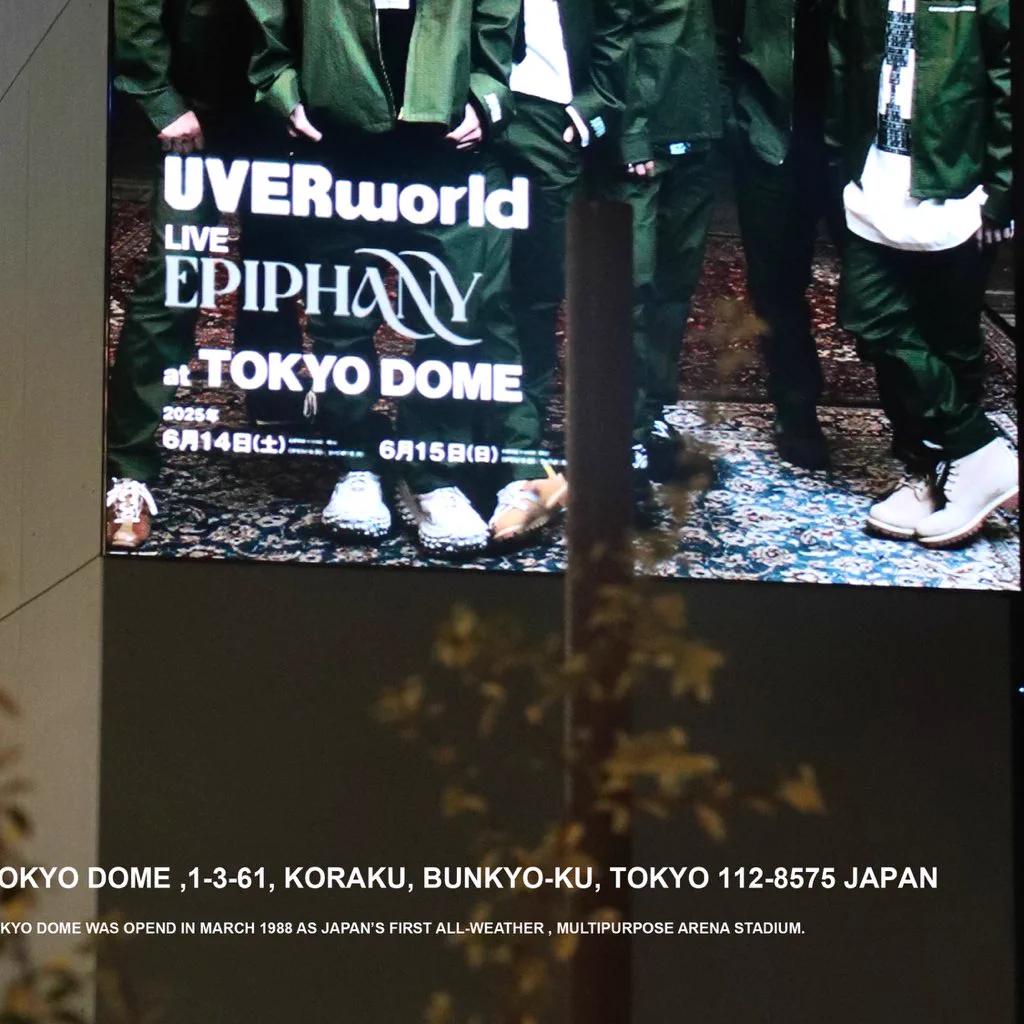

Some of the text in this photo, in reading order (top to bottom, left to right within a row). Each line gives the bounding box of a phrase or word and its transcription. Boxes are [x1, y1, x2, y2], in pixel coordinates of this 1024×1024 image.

[163, 155, 530, 230] UVERworld
[164, 223, 229, 252] LIVE
[164, 248, 483, 346] EPIPHANY
[163, 348, 523, 403] at TOKYO DOME
[162, 406, 219, 422] 2025年
[162, 429, 286, 454] 6月14日(土)
[379, 439, 499, 463] 6月15日(日)
